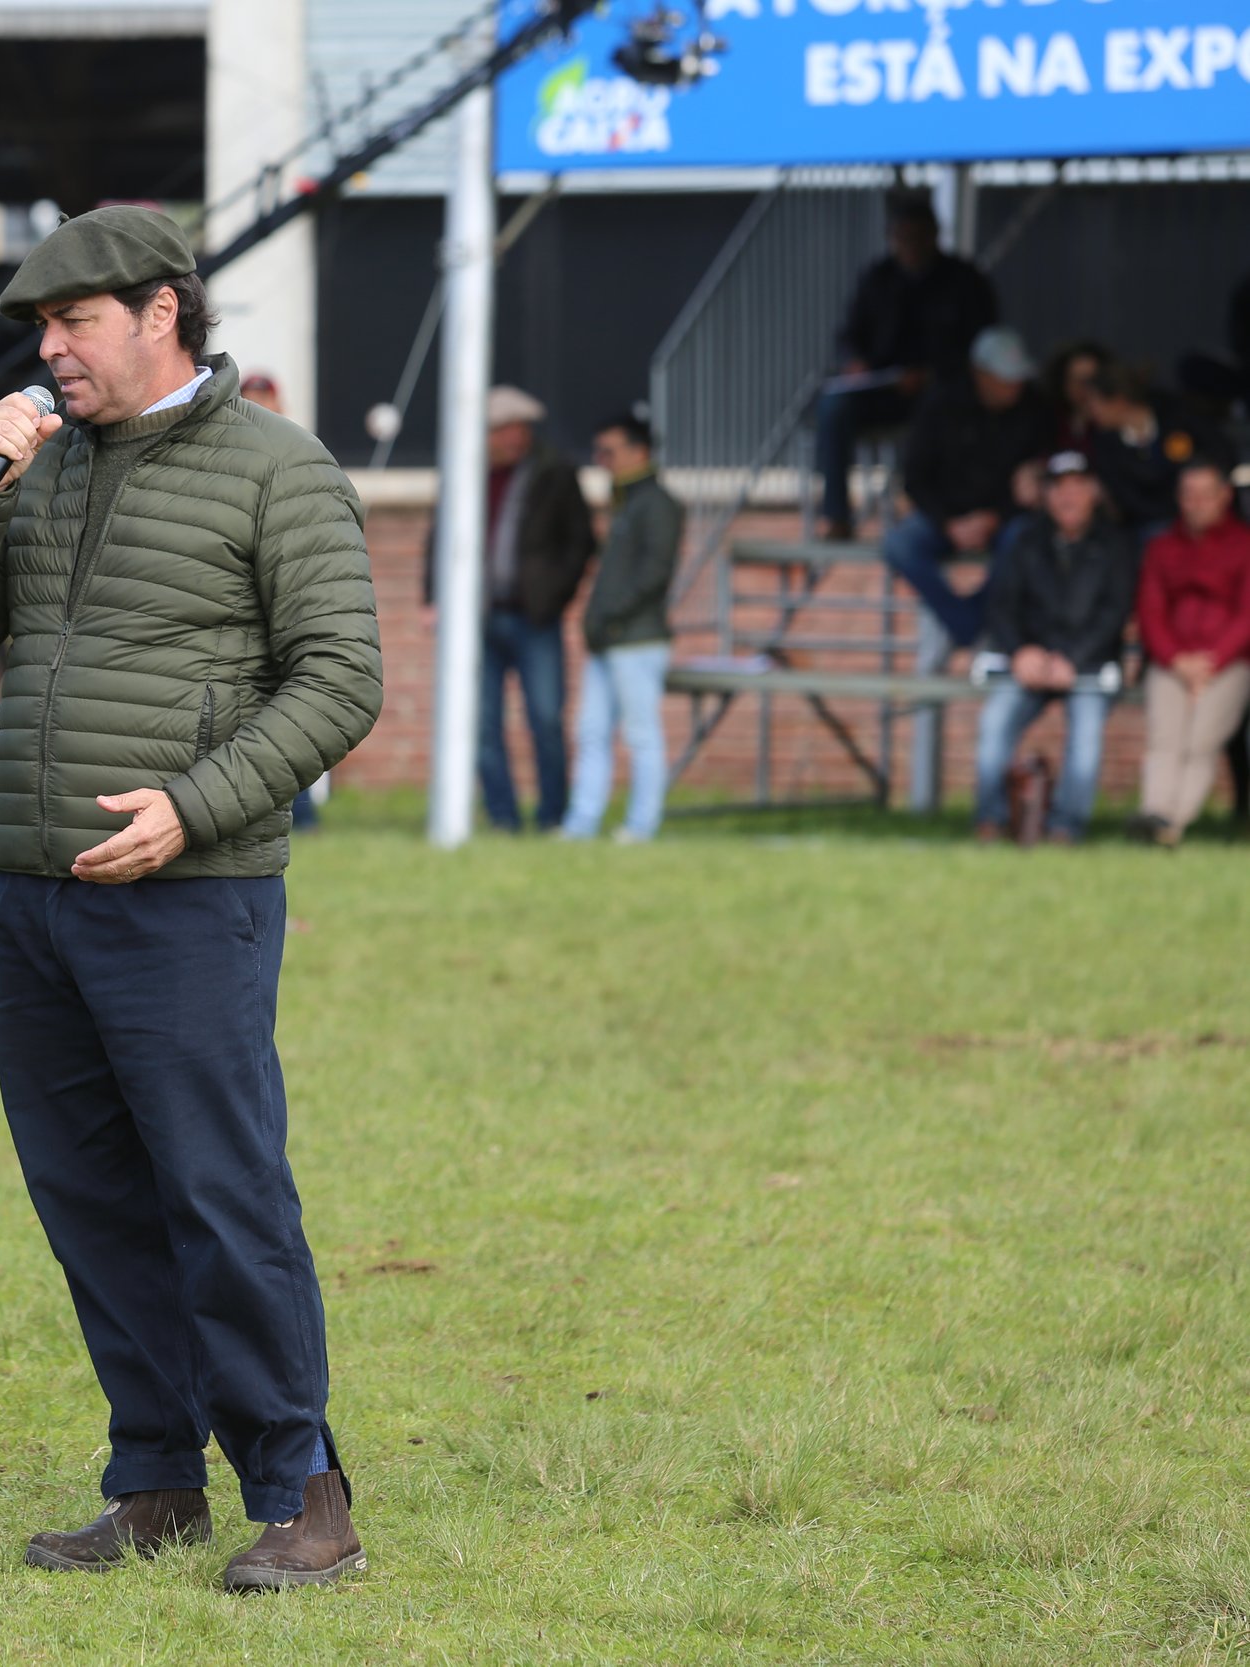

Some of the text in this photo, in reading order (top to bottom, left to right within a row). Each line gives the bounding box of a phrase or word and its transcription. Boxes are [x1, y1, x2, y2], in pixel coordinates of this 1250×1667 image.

[805, 25, 1250, 104] ESTÁ NA EXP
